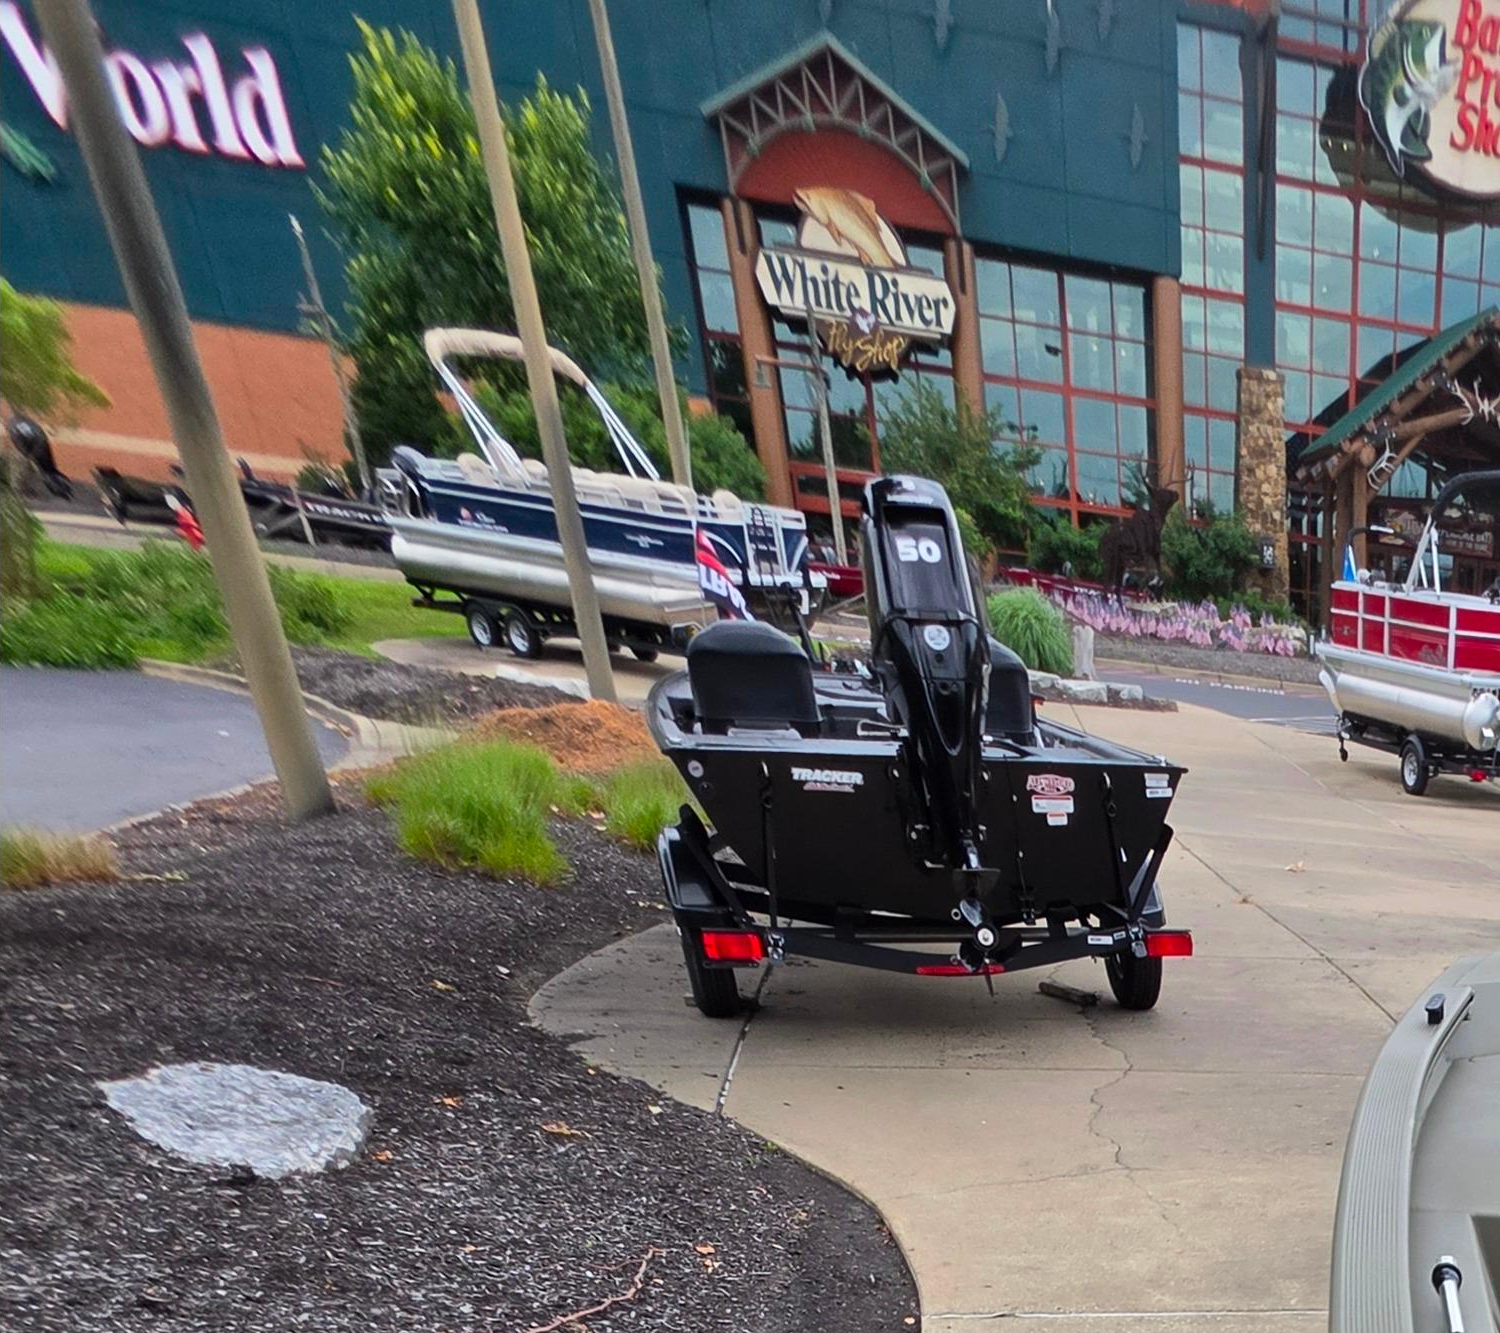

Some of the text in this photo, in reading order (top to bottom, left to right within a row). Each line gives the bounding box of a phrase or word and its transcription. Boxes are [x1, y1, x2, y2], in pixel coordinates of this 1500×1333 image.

[761, 249, 949, 328] White River
[894, 535, 942, 563] 50
[790, 766, 865, 786] TRACKER
